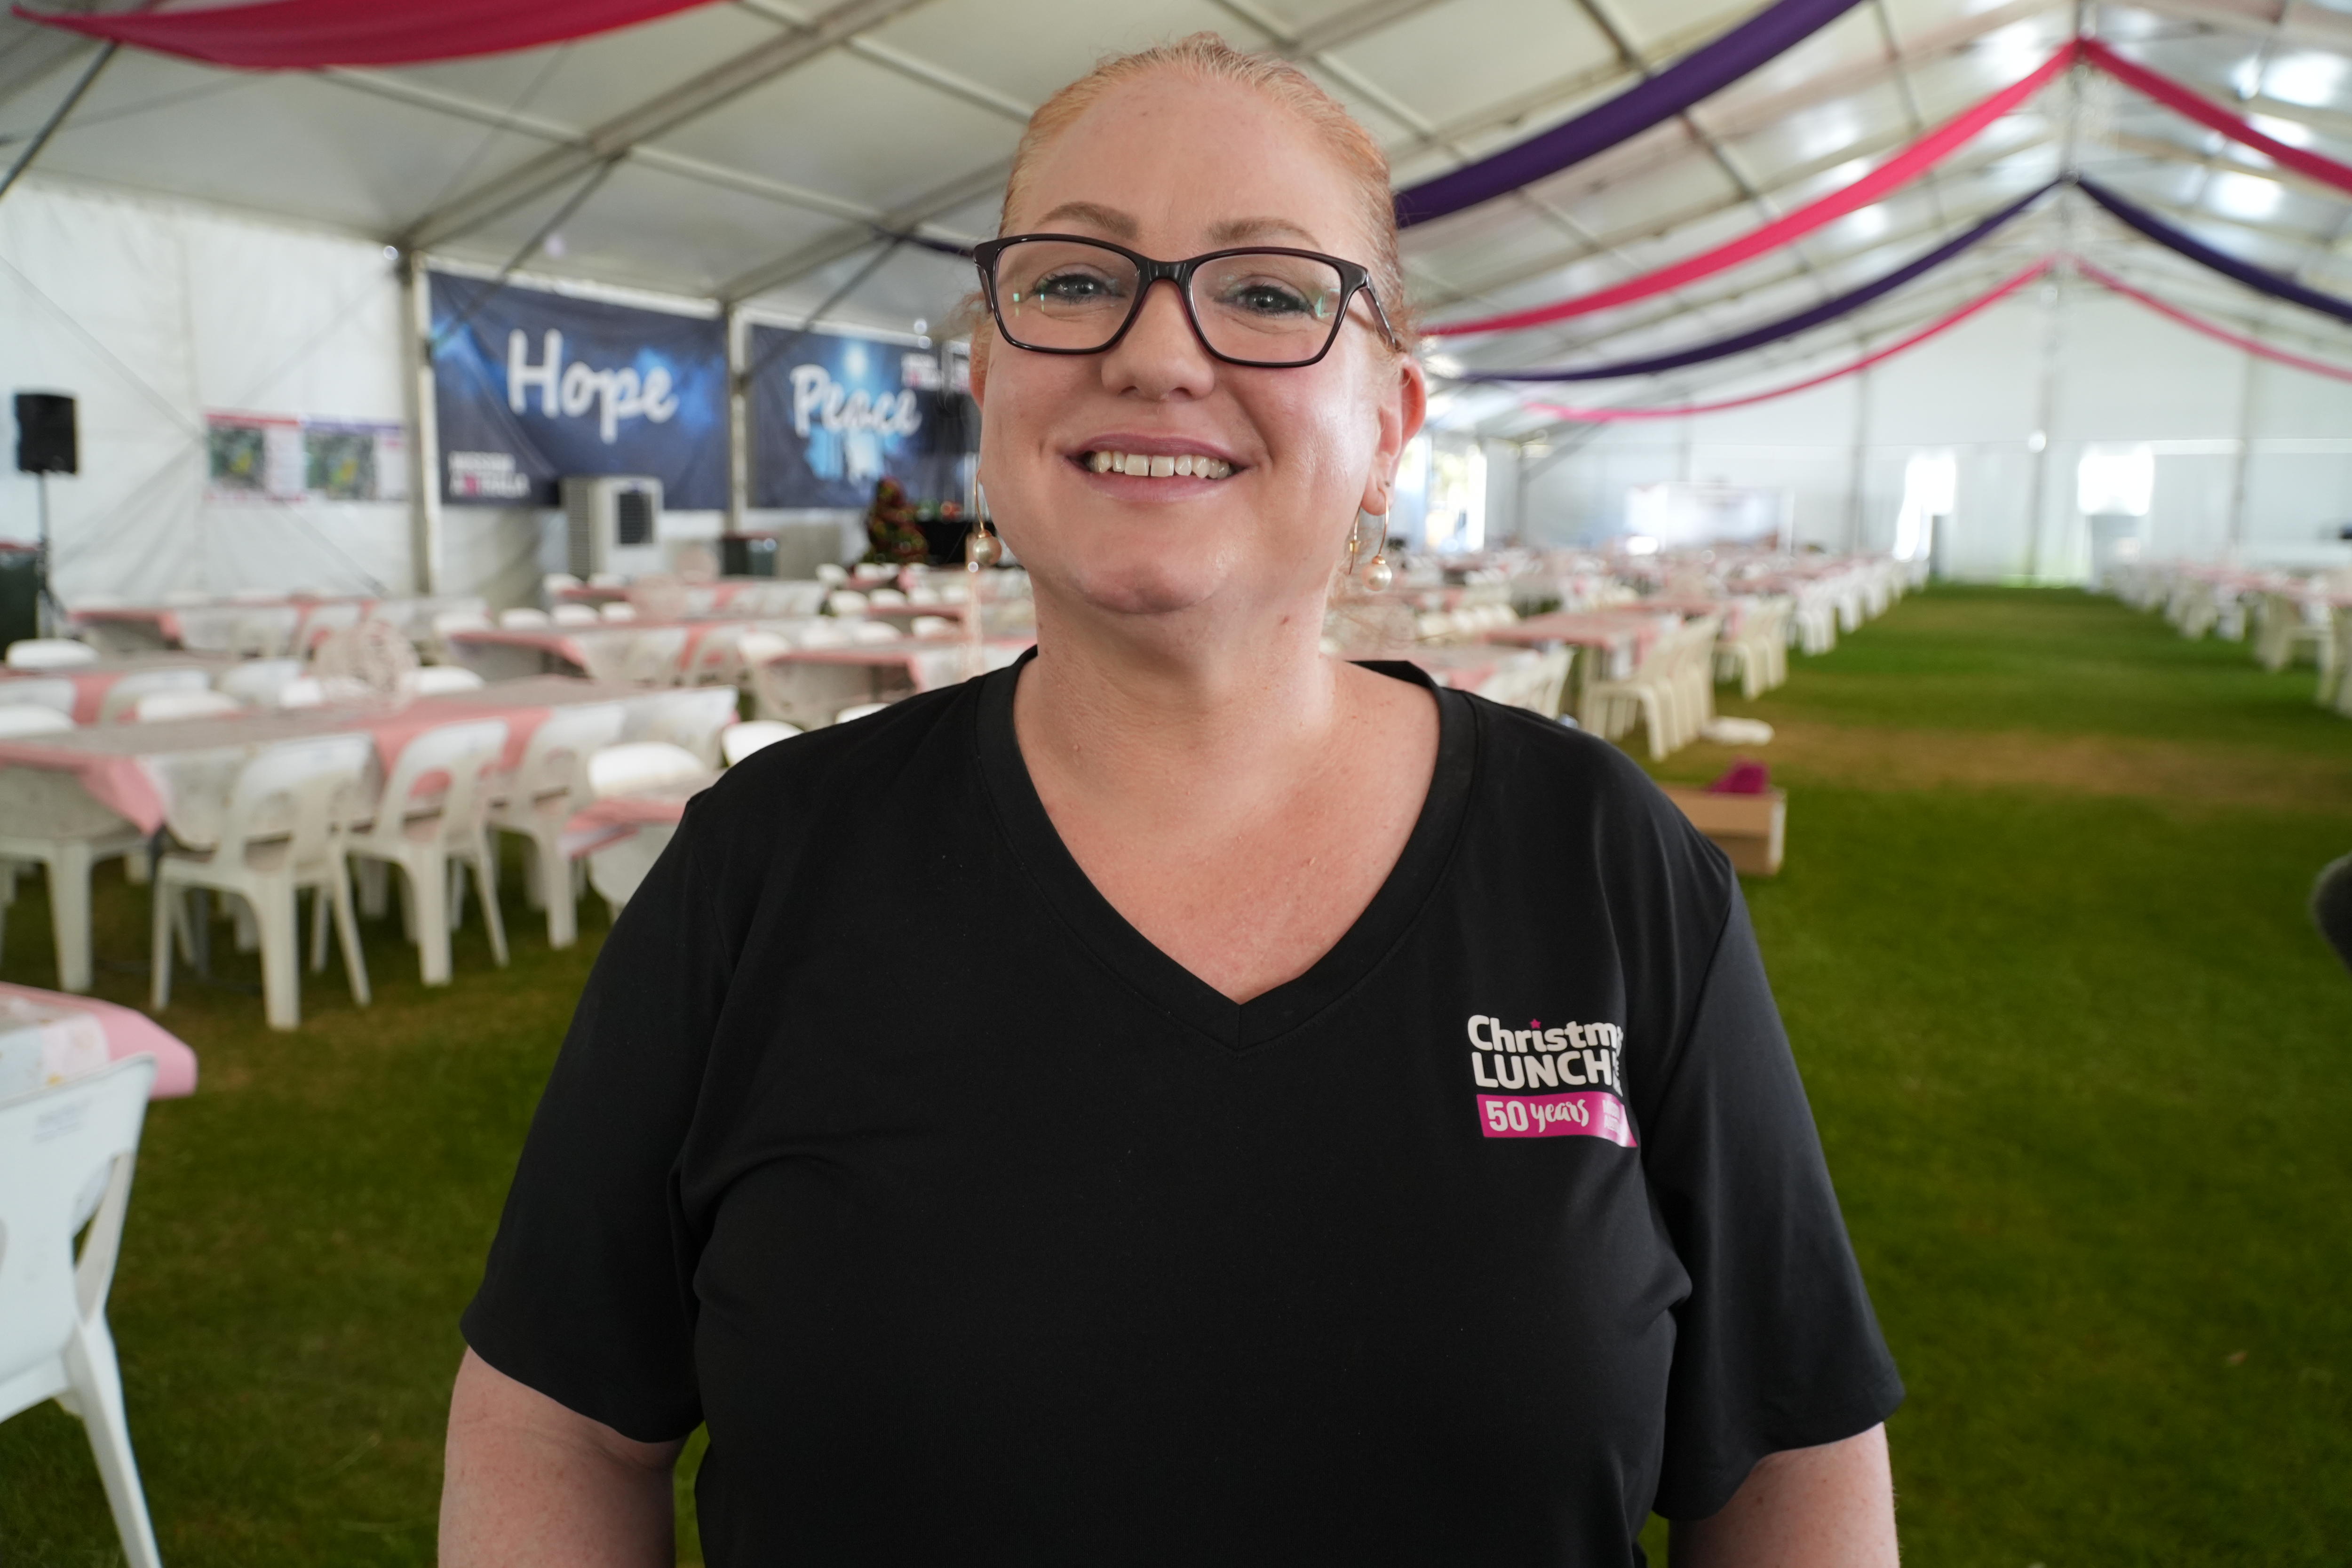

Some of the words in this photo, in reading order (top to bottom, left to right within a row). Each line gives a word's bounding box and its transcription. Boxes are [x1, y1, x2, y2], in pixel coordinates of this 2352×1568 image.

[507, 328, 679, 444] Hope
[790, 364, 922, 438] Peace
[1471, 1049, 1612, 1089] LUNCH
[1486, 1101, 1529, 1132] 50
[1530, 1099, 1589, 1133] years
